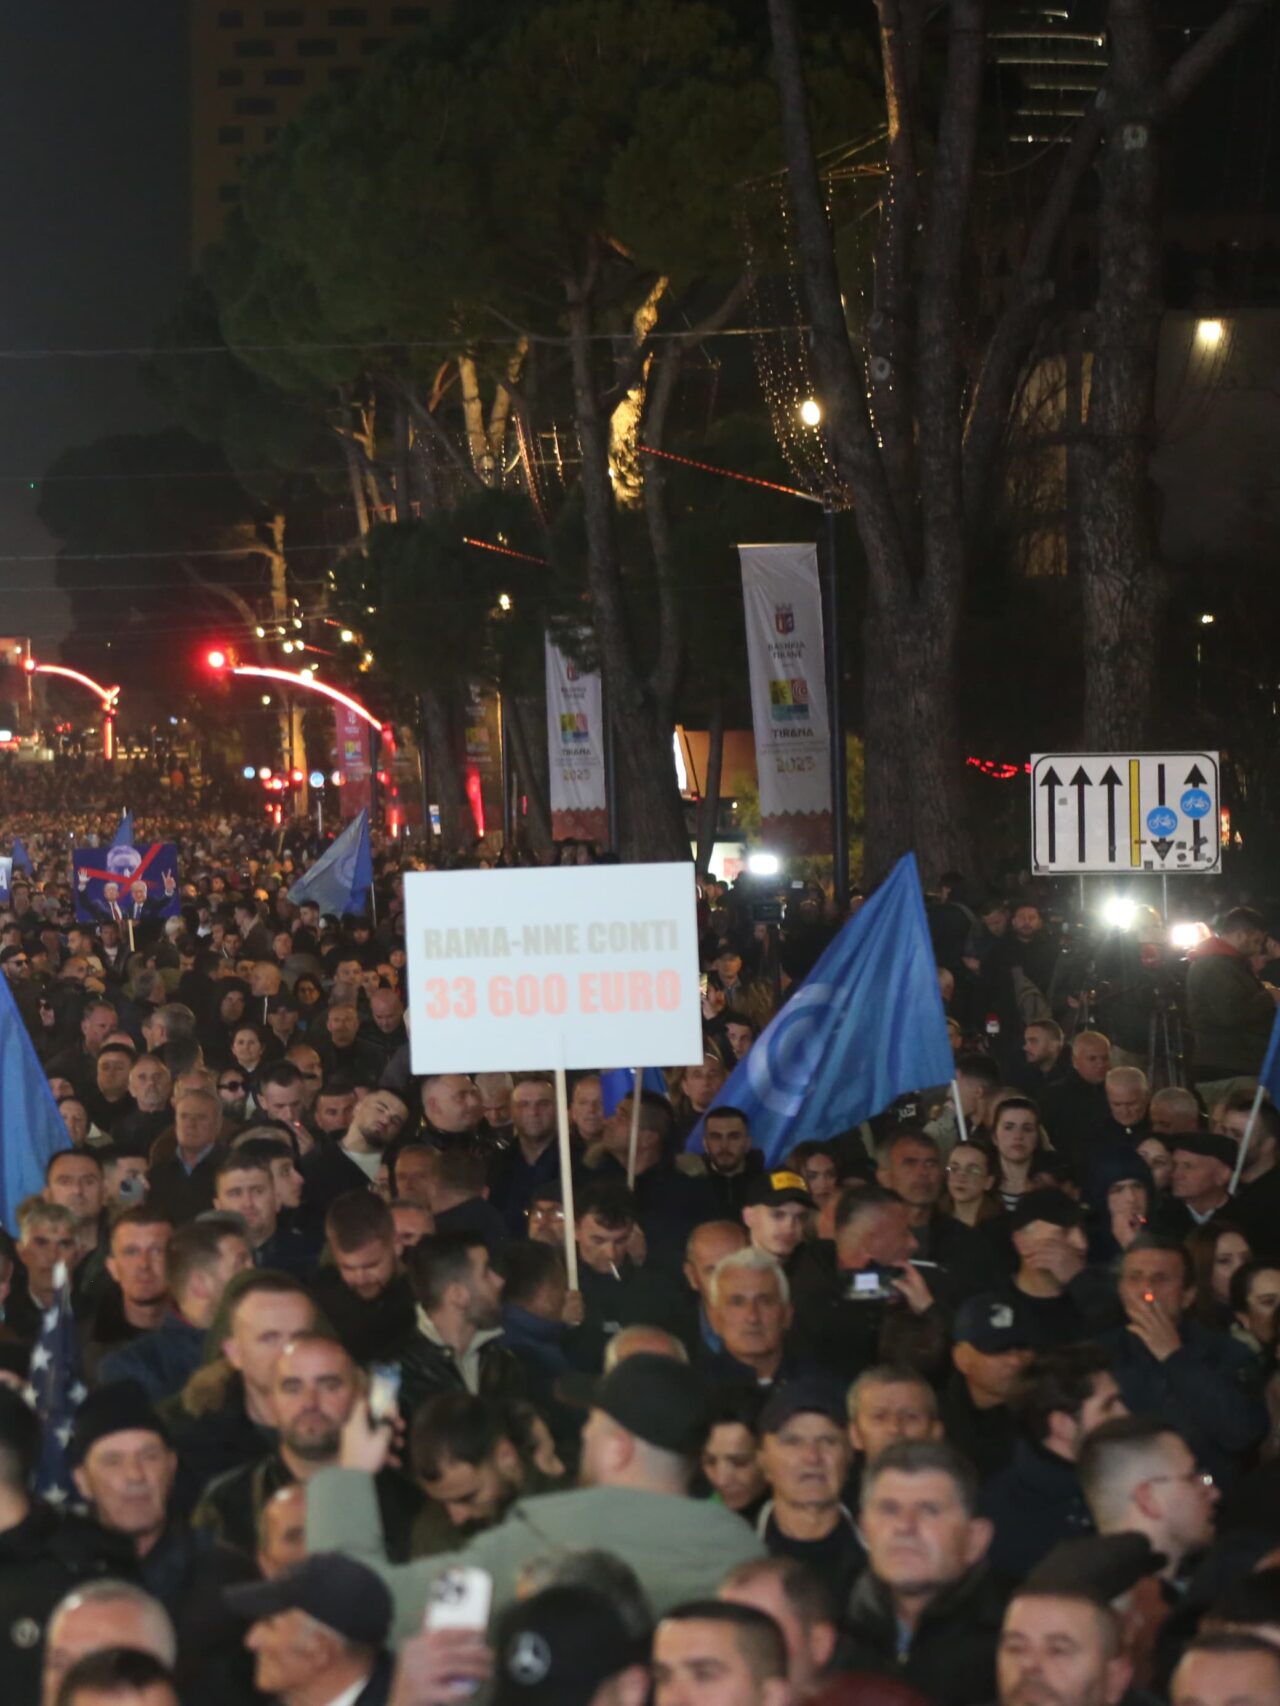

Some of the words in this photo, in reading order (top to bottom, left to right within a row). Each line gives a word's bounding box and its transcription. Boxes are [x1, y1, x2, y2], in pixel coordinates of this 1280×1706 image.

[424, 923, 580, 960] RAMA-NNE
[587, 919, 678, 954] CONTI
[425, 975, 477, 1020] 33
[487, 971, 568, 1018] 600
[577, 968, 682, 1014] EURO
